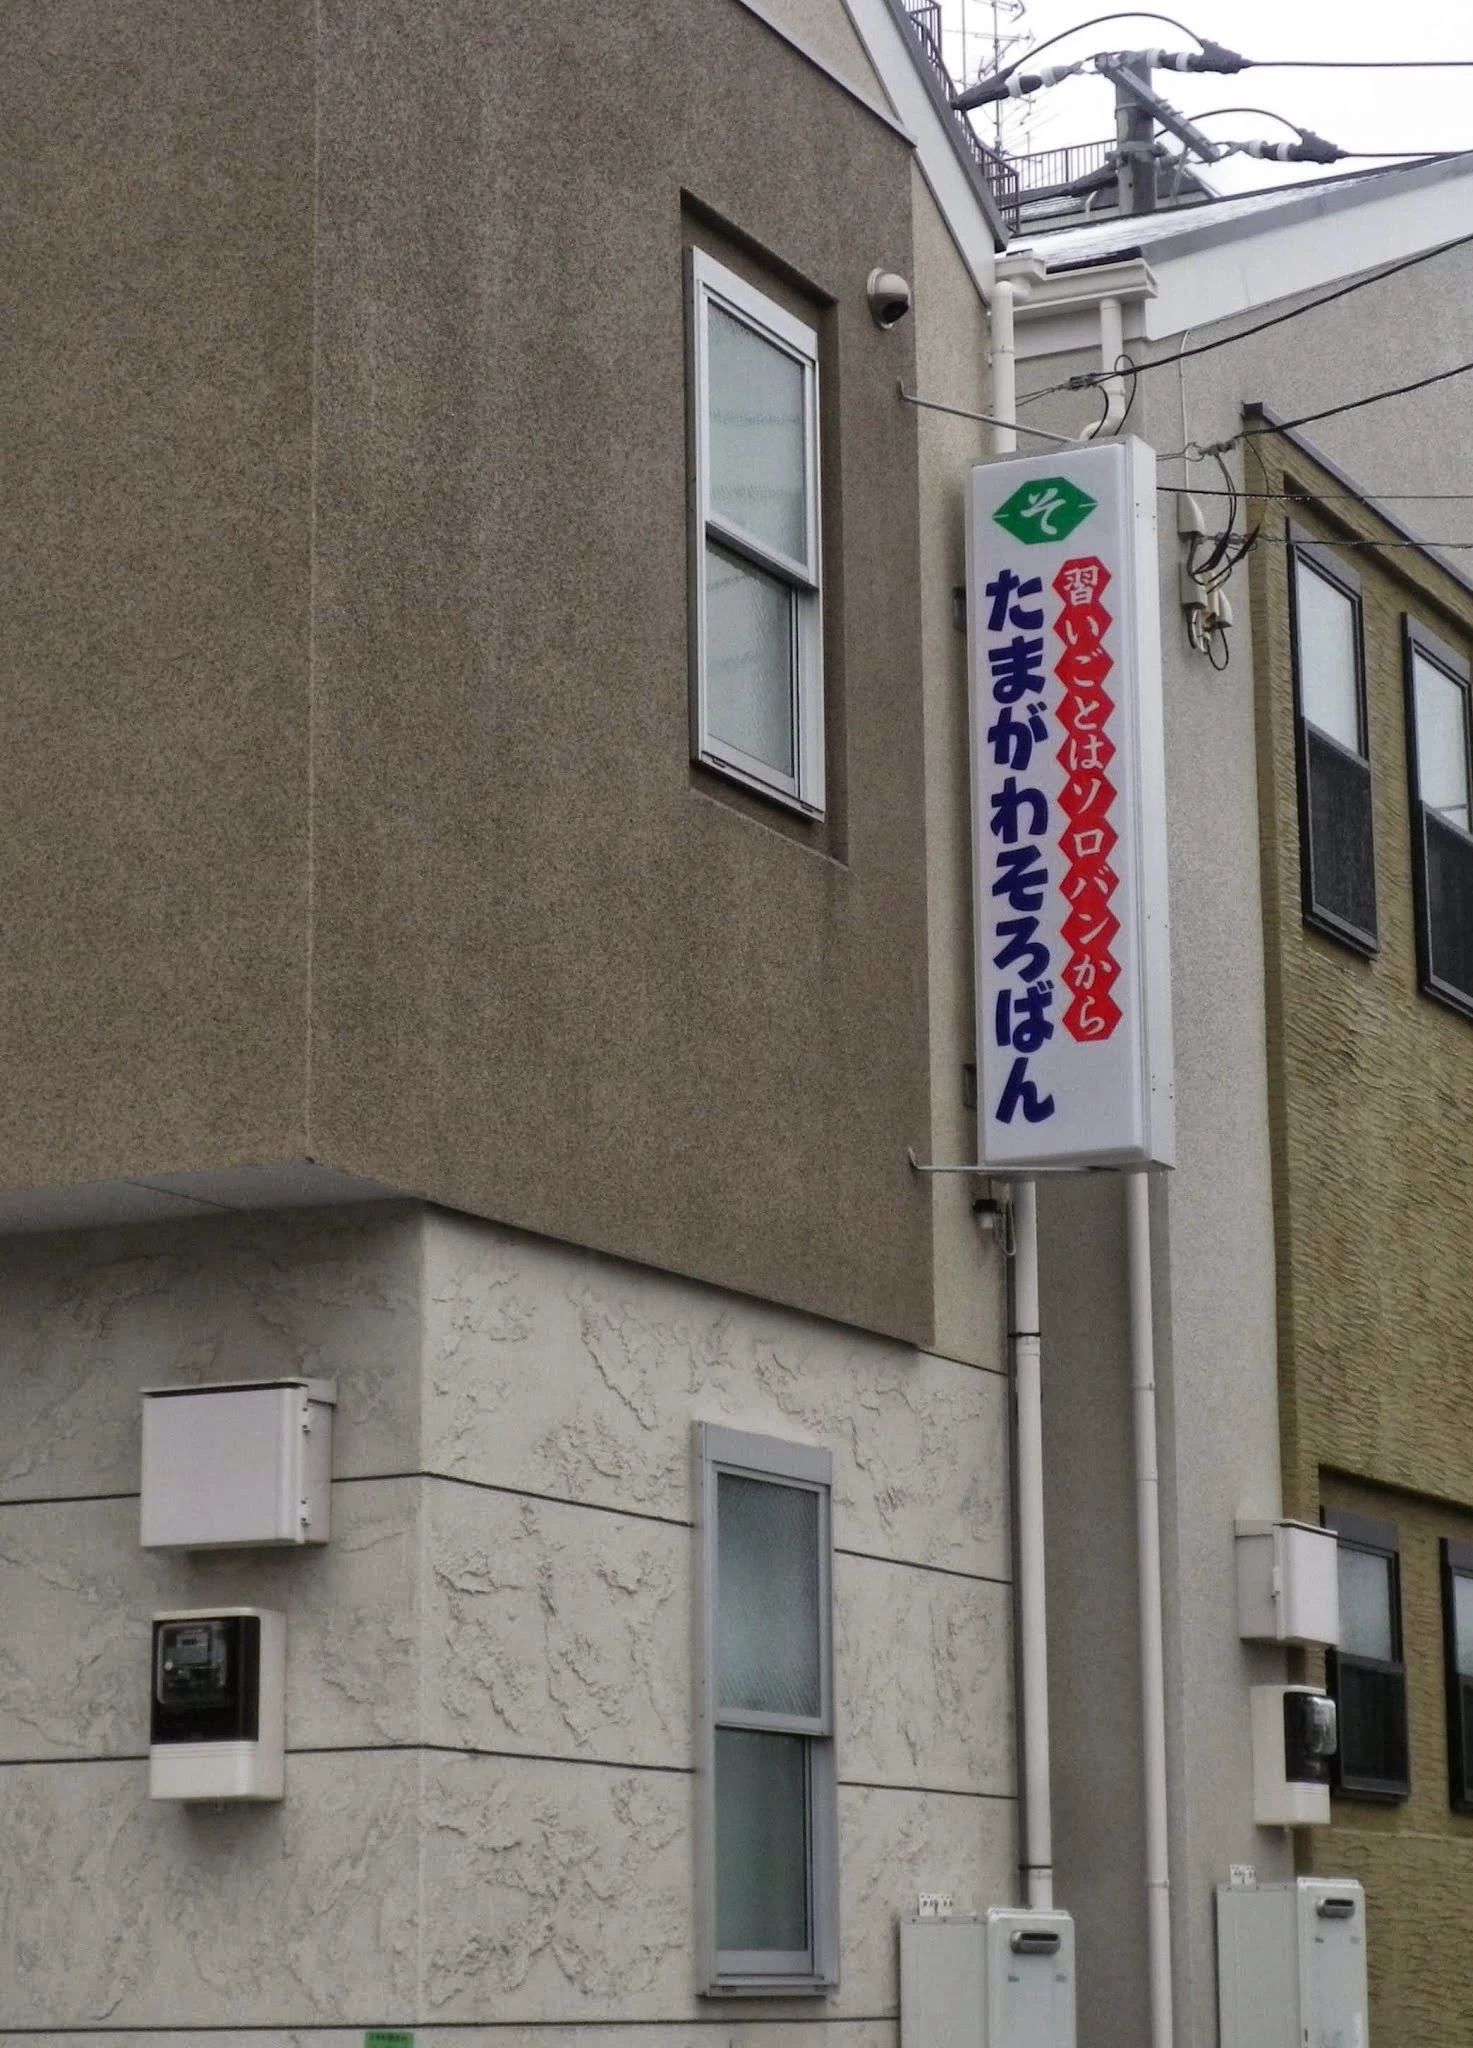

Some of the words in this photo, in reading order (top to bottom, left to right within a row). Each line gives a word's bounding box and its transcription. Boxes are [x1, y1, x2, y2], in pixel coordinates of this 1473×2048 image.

[985, 568, 1055, 1125] たまがわそろばん
[1063, 565, 1112, 1036] 習いごとはソロバンから
